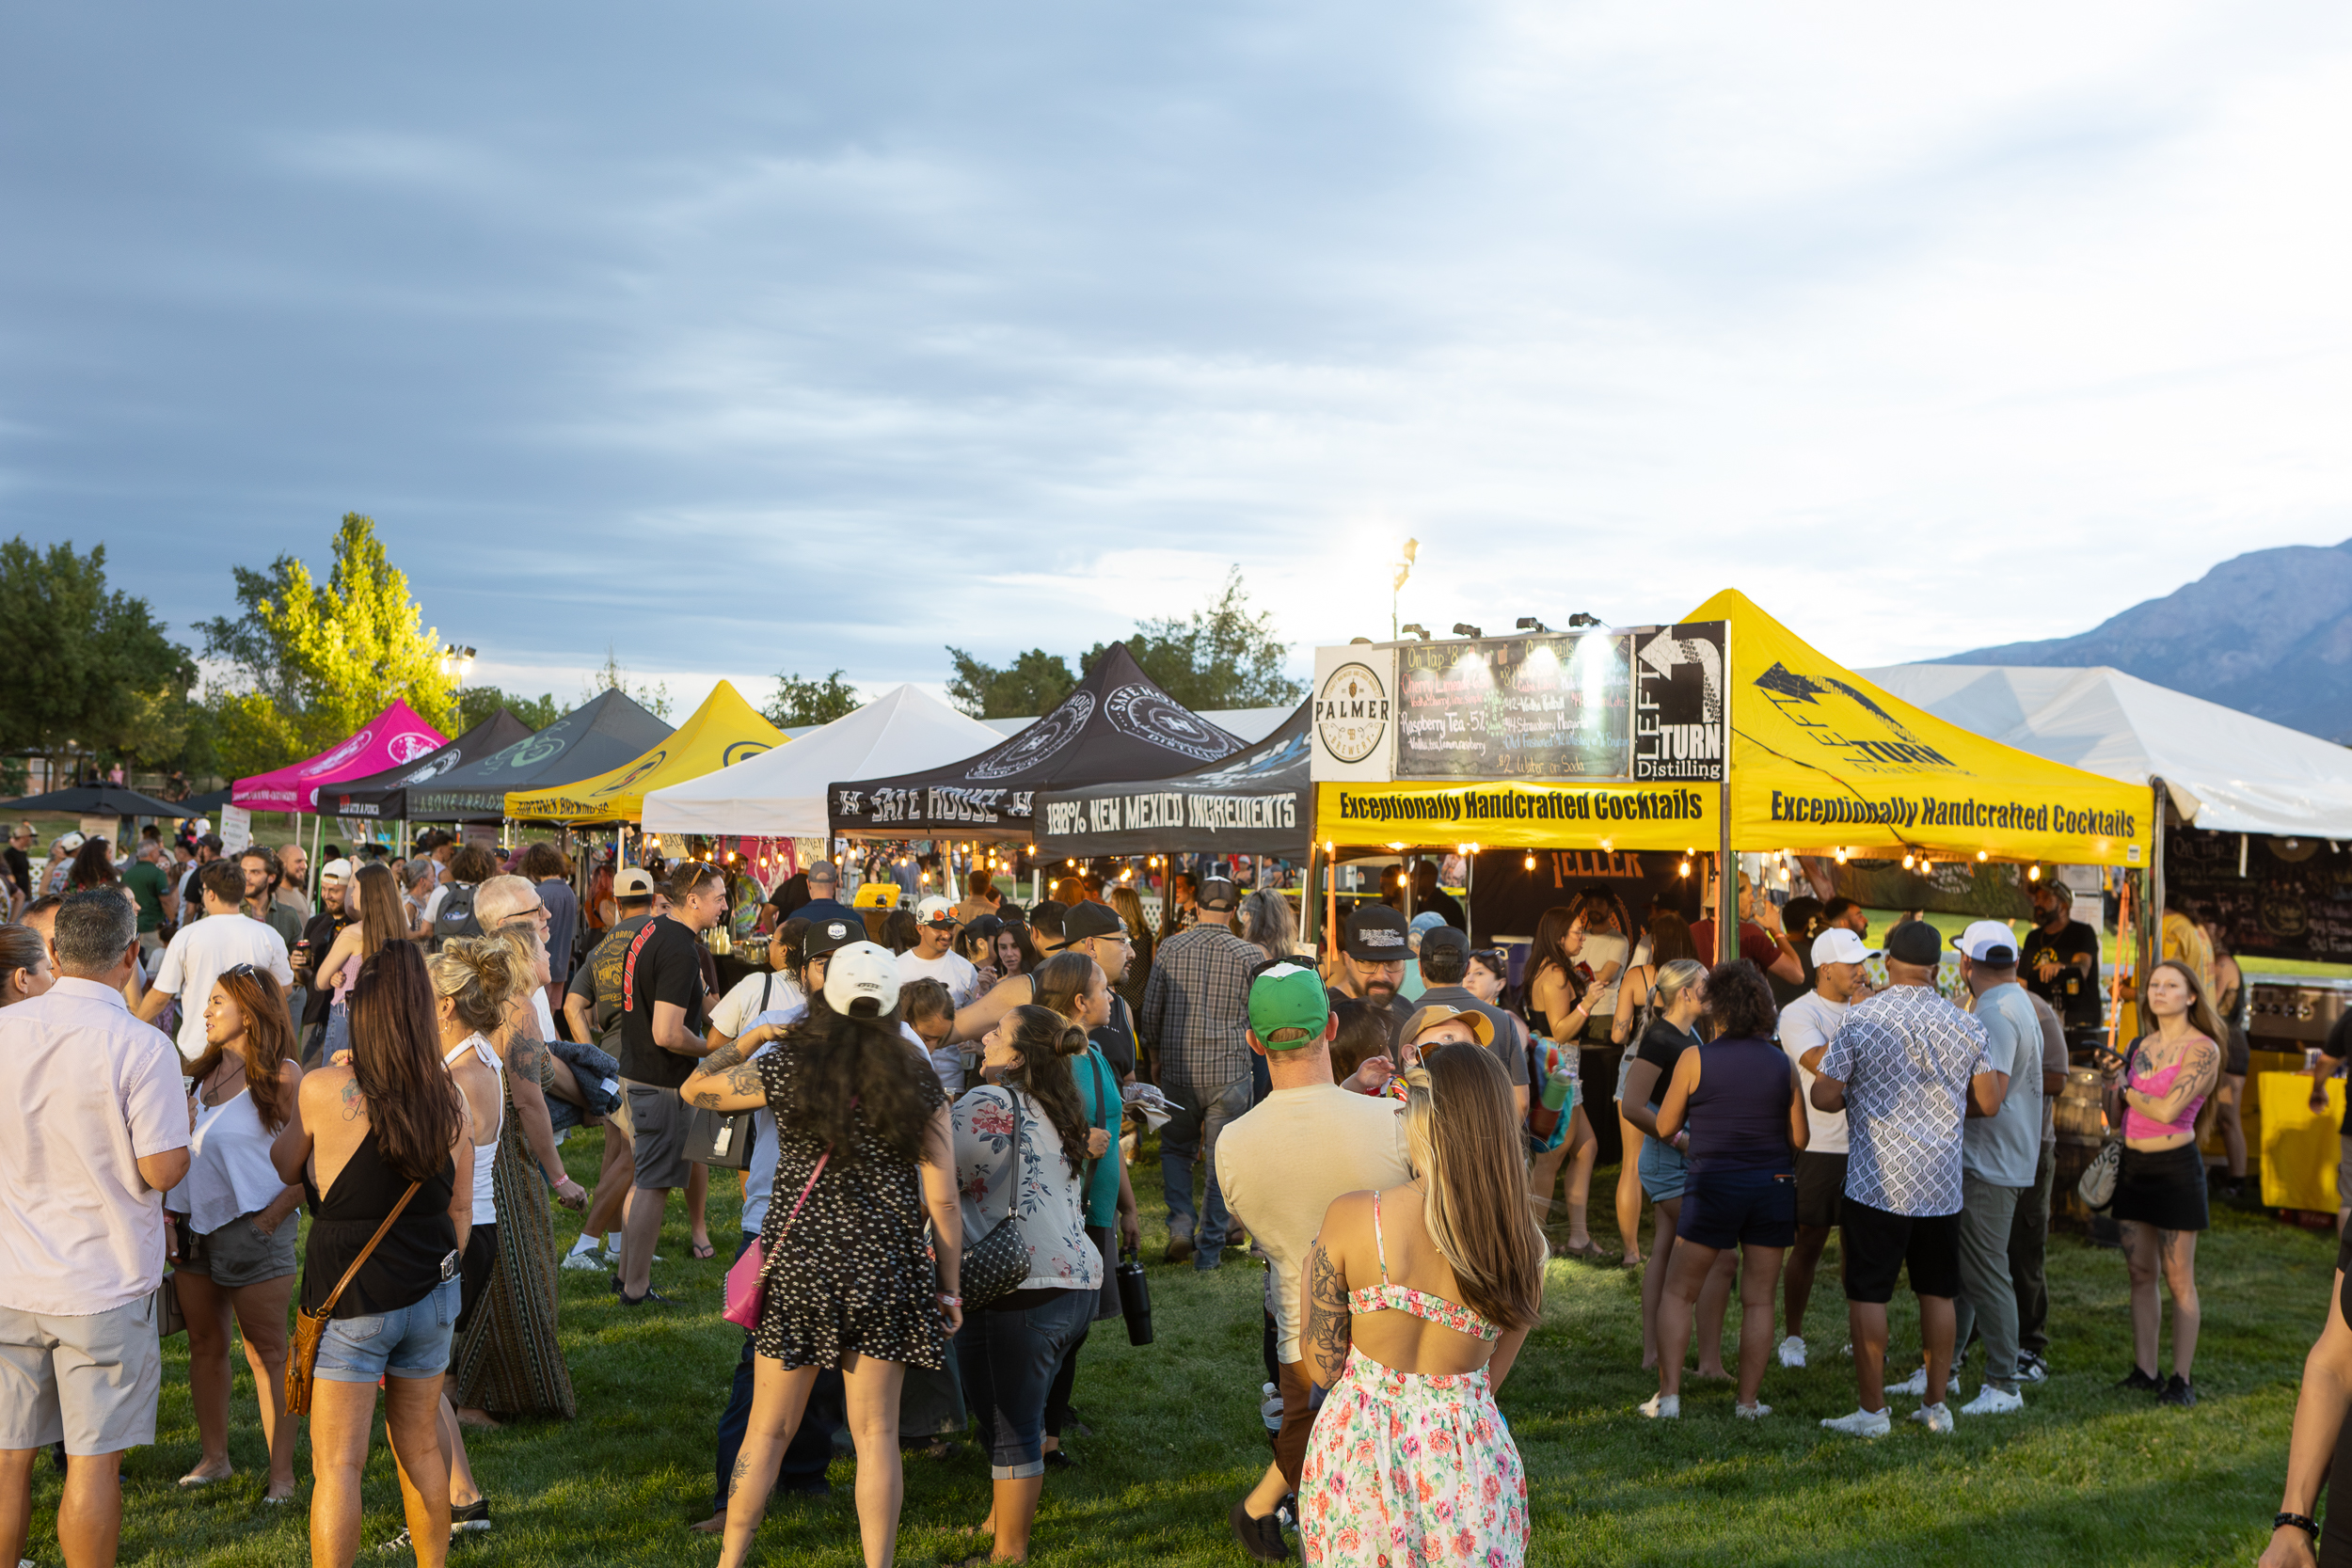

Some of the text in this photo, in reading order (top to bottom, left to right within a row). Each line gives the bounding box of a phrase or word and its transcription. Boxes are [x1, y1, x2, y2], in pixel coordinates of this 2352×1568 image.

[1407, 647, 1422, 668] On
[1110, 686, 1140, 712] SAFE
[1402, 673, 1434, 701] Cherry
[1315, 700, 1390, 722] PALMER
[1637, 659, 1661, 760] LEFT
[1401, 711, 1446, 738] Raspberry
[1444, 711, 1466, 732] Tea
[1330, 735, 1373, 755] BREWERY
[1505, 733, 1520, 750] Old
[1660, 723, 1721, 760] TURN
[1857, 738, 1958, 768] TURN
[1517, 755, 1545, 773] Water
[1561, 754, 1585, 772] Soda
[1637, 760, 1721, 779] Distilling
[869, 787, 921, 822] SAFE
[927, 786, 1008, 823] HOUSE
[1046, 792, 1297, 835] 100% NEW MEXICO INGREDIENTS
[1340, 788, 1703, 822] Exceptionally Handcrafted Cocktails
[1772, 789, 2136, 839] Exceptionally Handcrafted Cocktails
